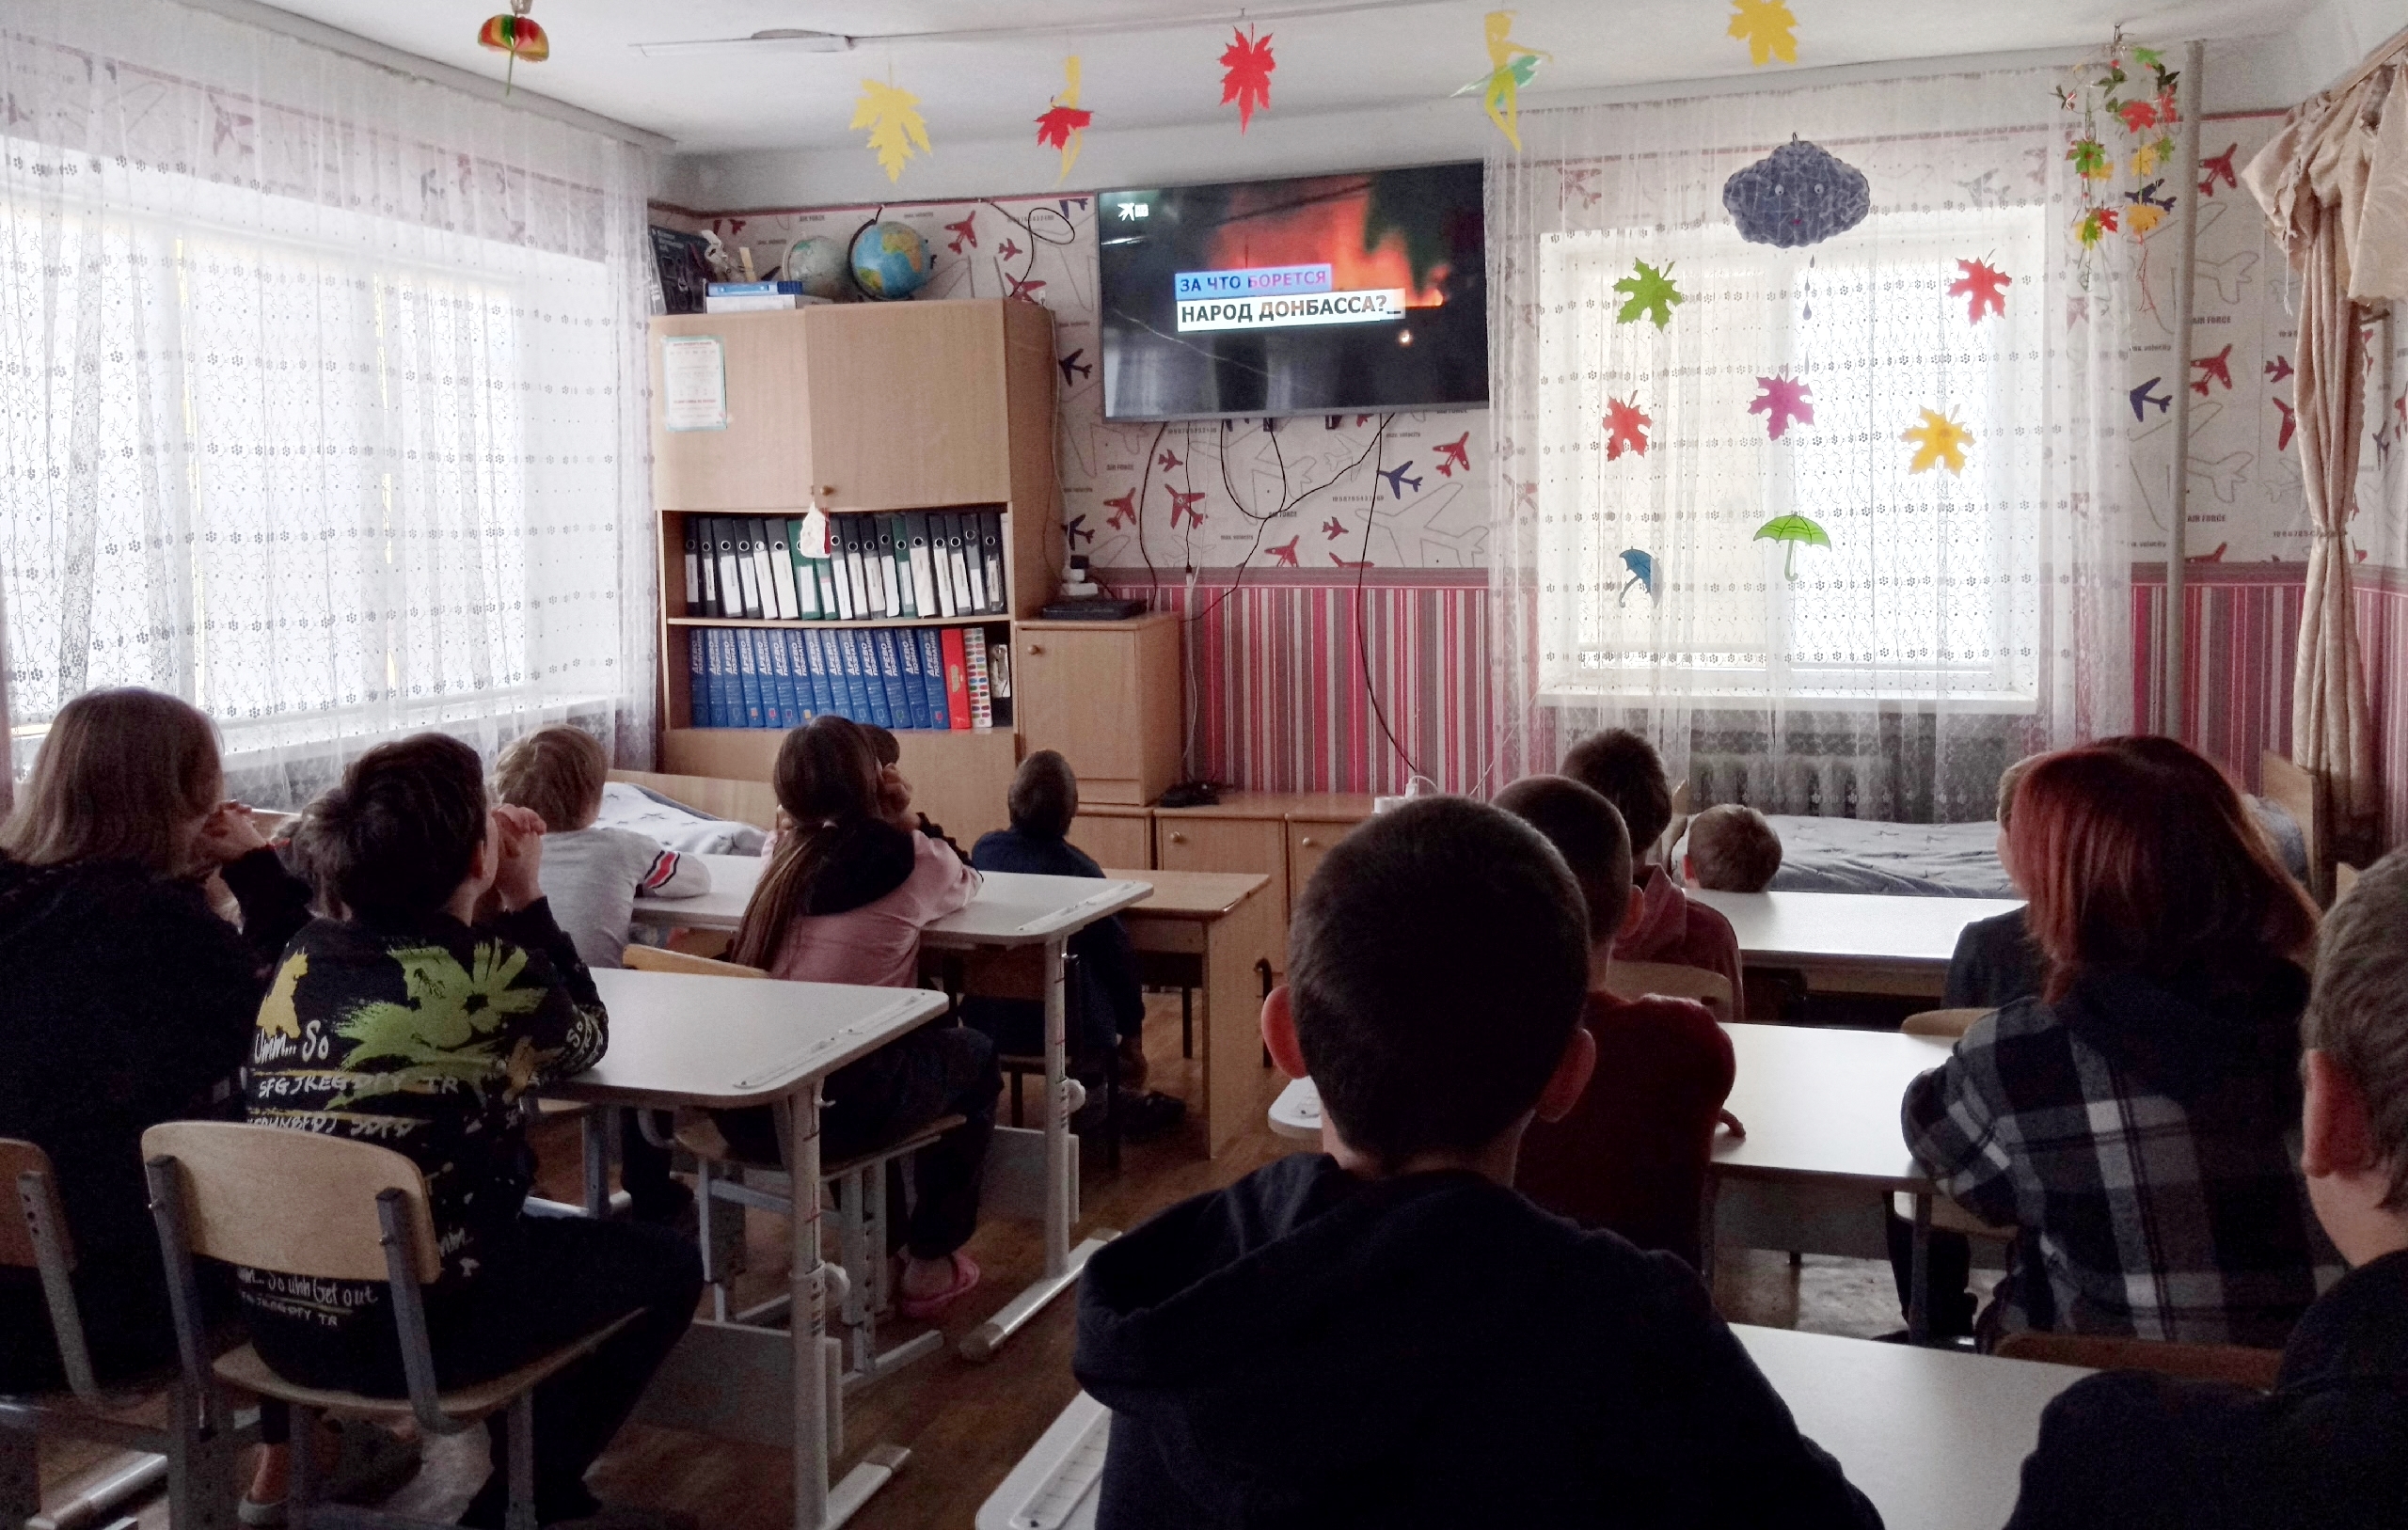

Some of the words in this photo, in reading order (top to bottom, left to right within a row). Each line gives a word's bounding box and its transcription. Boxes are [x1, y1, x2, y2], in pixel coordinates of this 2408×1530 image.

[1180, 277, 1202, 292] ЗА
[1207, 276, 1242, 291] ЧТО
[1247, 271, 1326, 289] БОРЕТСЯ
[1181, 303, 1253, 323] НАРОД
[302, 1019, 329, 1063] So
[343, 1285, 379, 1307] out
